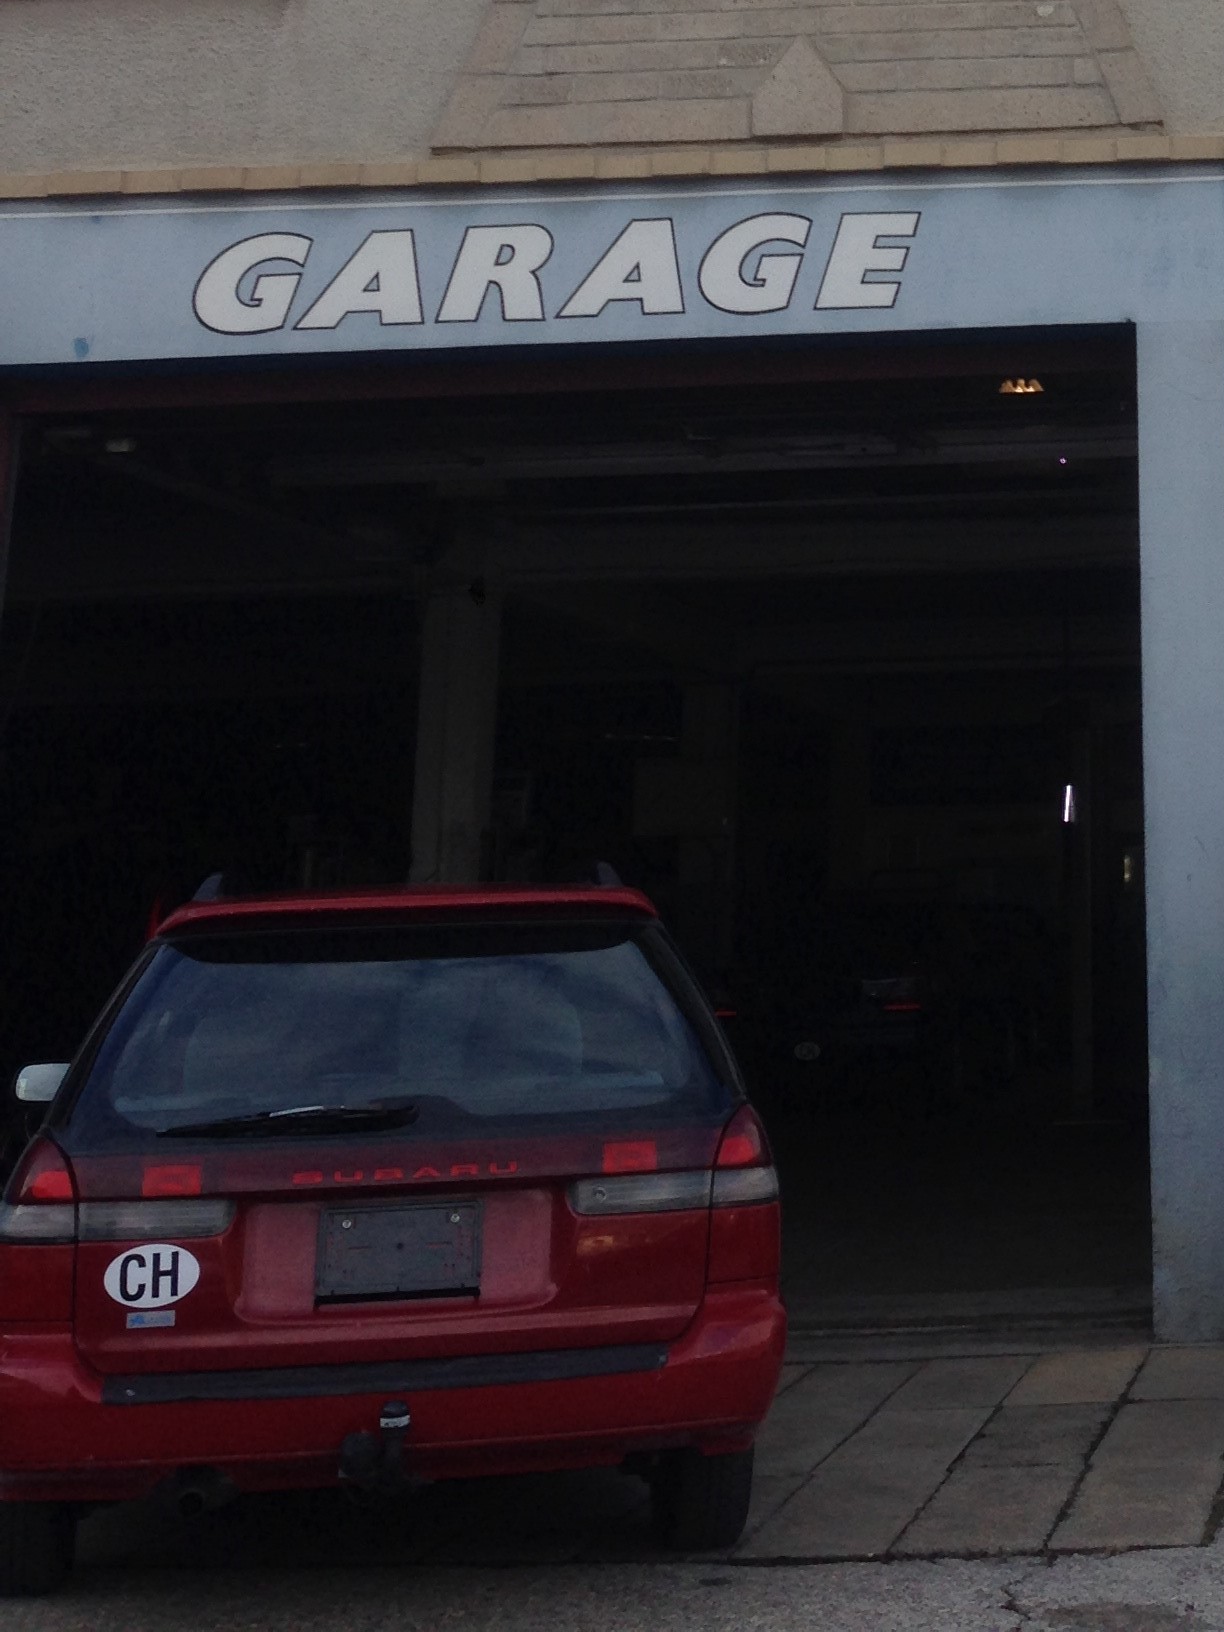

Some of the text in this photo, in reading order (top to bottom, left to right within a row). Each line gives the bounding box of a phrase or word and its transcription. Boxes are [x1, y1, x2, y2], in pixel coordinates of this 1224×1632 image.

[192, 211, 922, 335] GARAGE
[292, 1160, 518, 1185] SUBARU
[119, 1251, 180, 1302] CH
